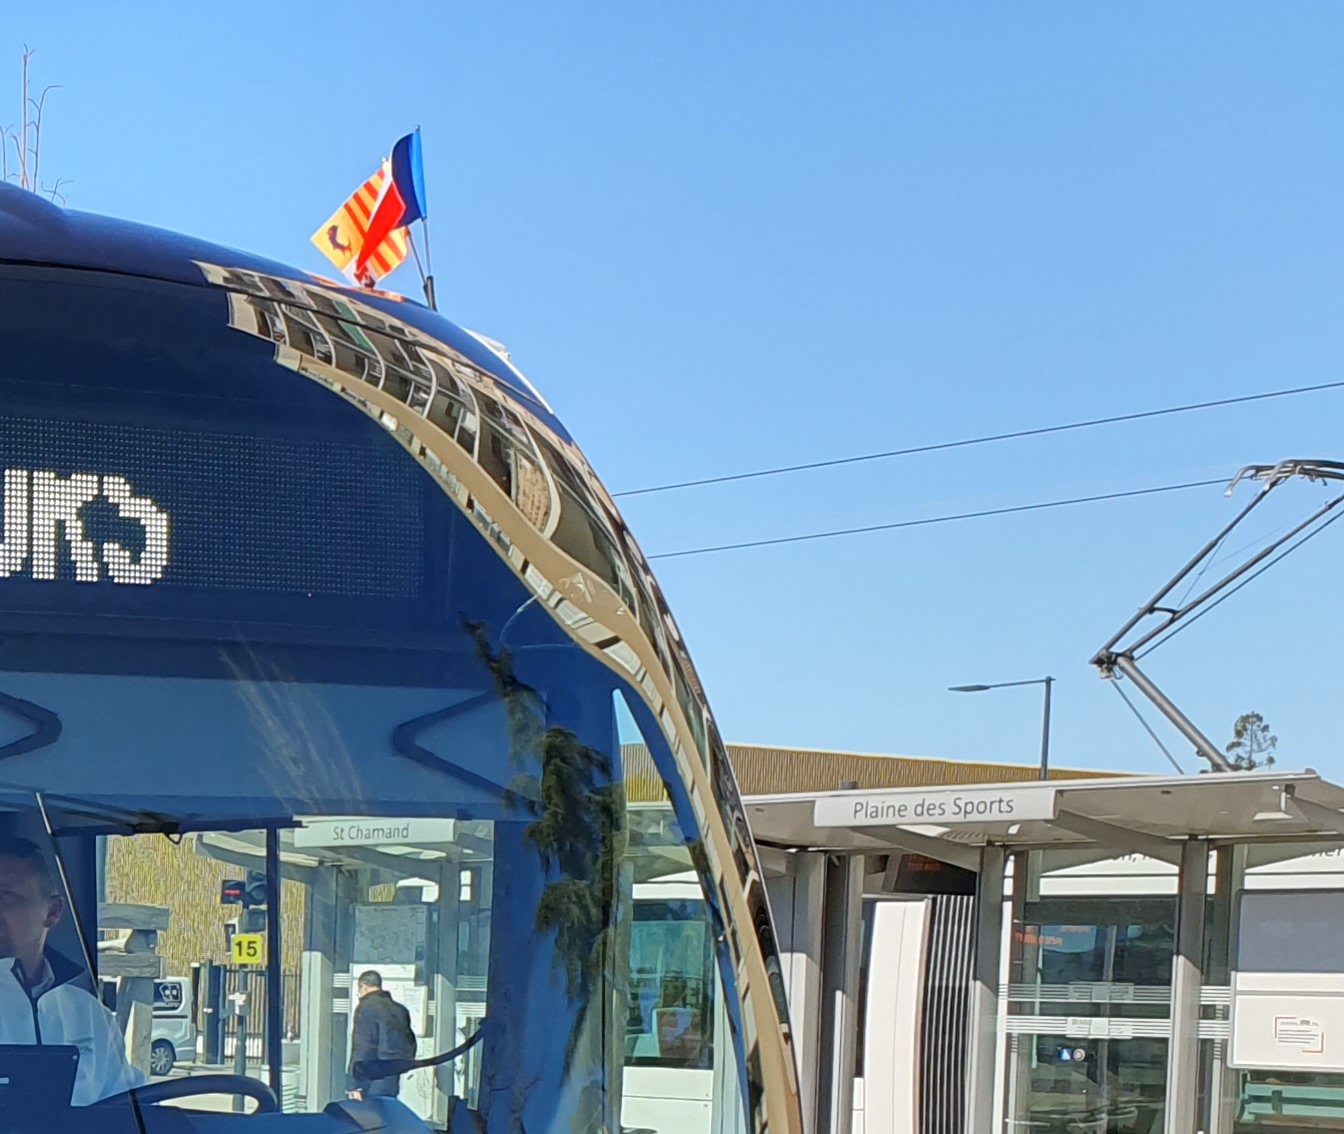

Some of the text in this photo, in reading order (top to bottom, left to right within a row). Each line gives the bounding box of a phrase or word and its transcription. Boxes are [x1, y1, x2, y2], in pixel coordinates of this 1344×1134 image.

[853, 796, 1014, 819] Plaine des Sports
[332, 823, 410, 841] St Chamand
[234, 940, 258, 958] 15
